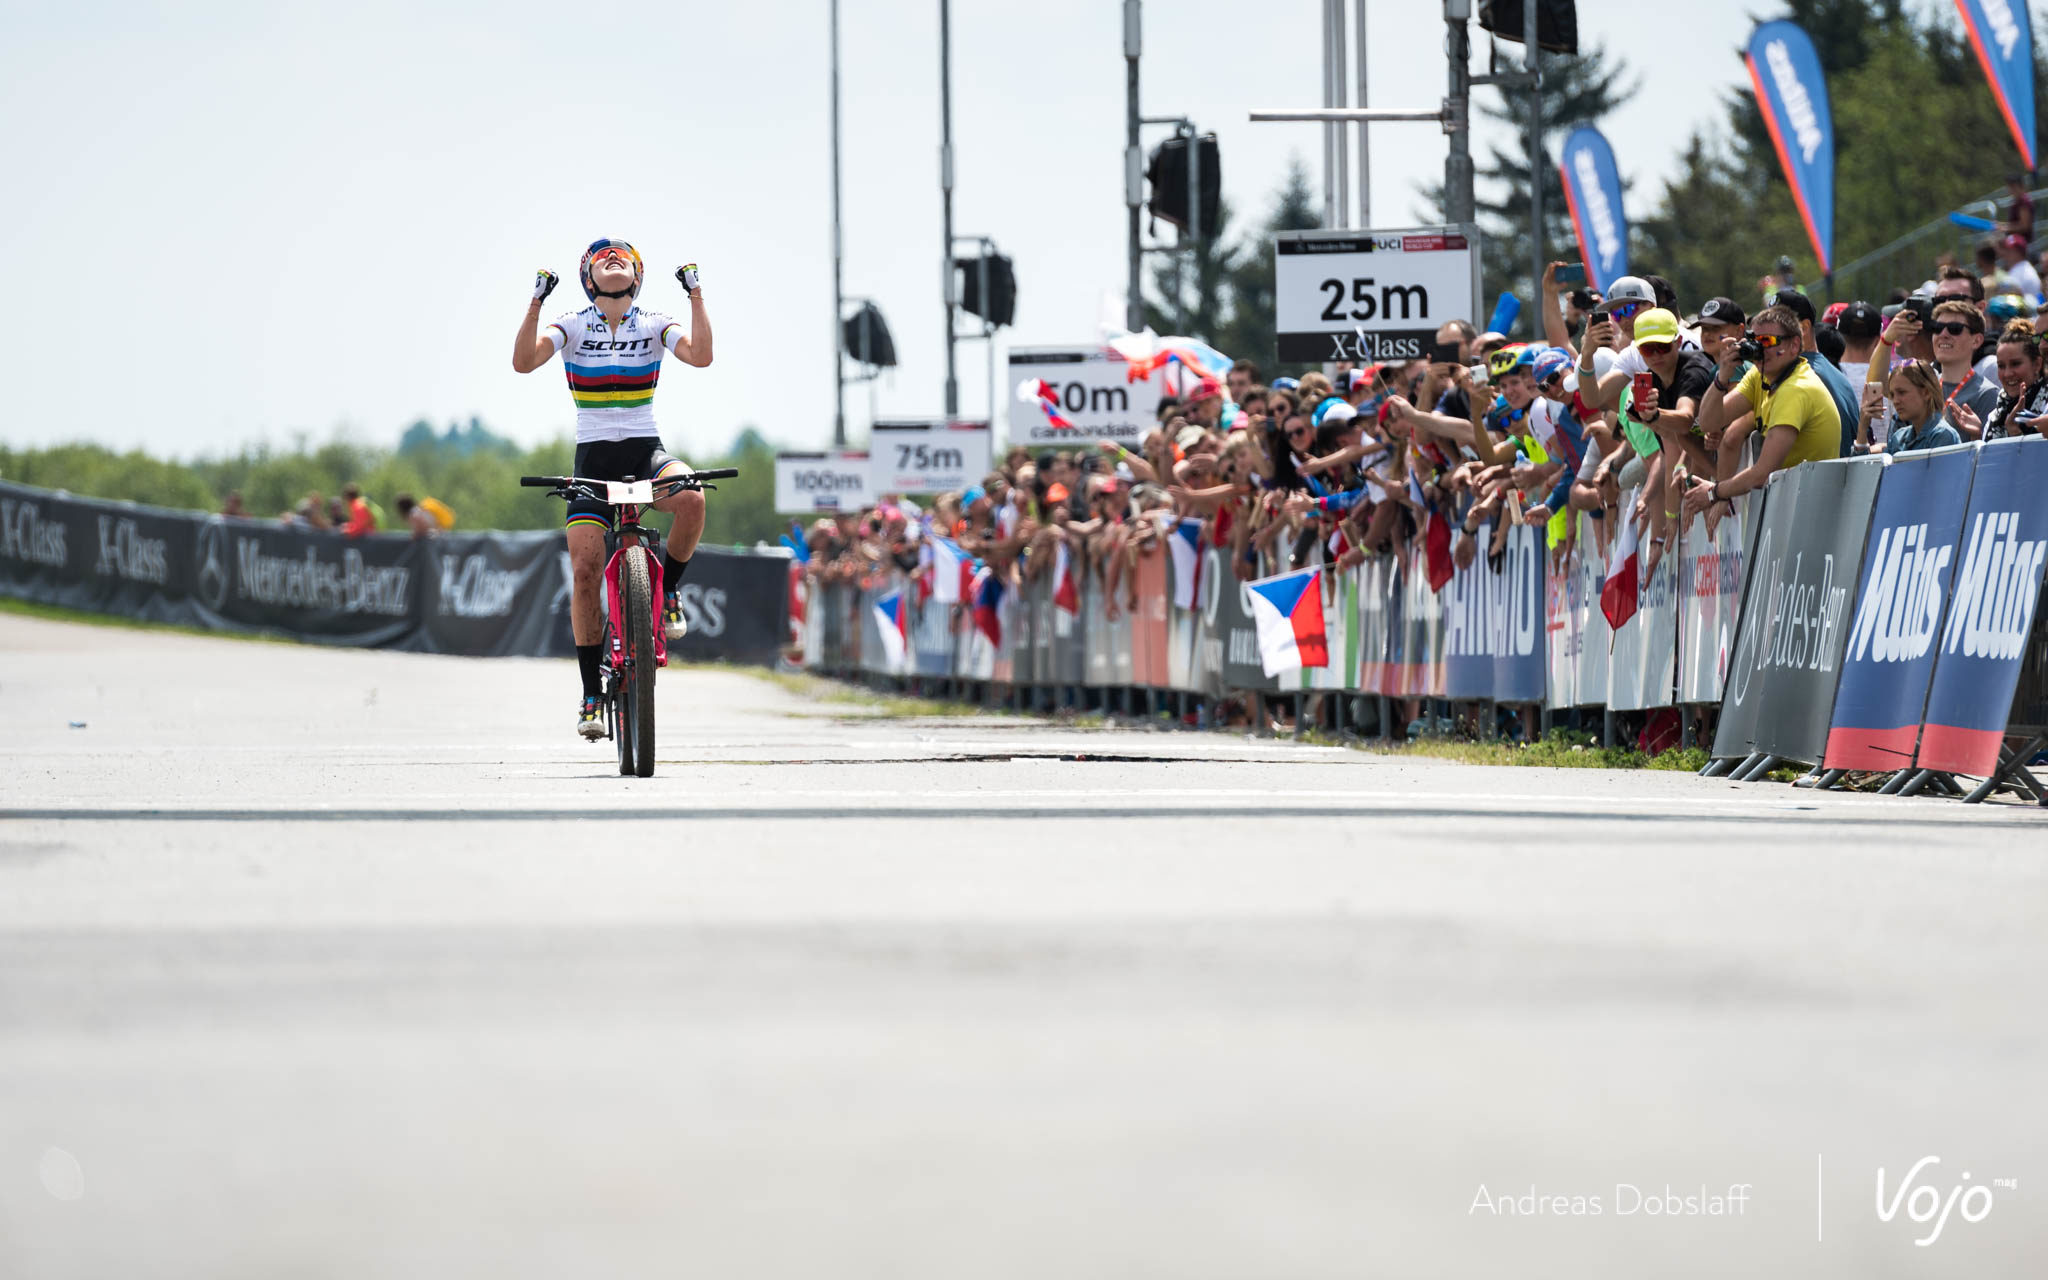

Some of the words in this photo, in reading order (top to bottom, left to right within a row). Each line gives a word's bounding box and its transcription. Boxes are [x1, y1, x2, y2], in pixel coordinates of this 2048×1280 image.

[1377, 238, 1401, 249] UCI
[1319, 277, 1429, 321] 25m
[580, 337, 653, 351] SCOTT
[1330, 333, 1420, 360] X-Class
[1044, 381, 1129, 413] 0m
[895, 443, 964, 469] 75m
[793, 471, 863, 491] 100m
[237, 536, 410, 616] Mercedes-Benz
